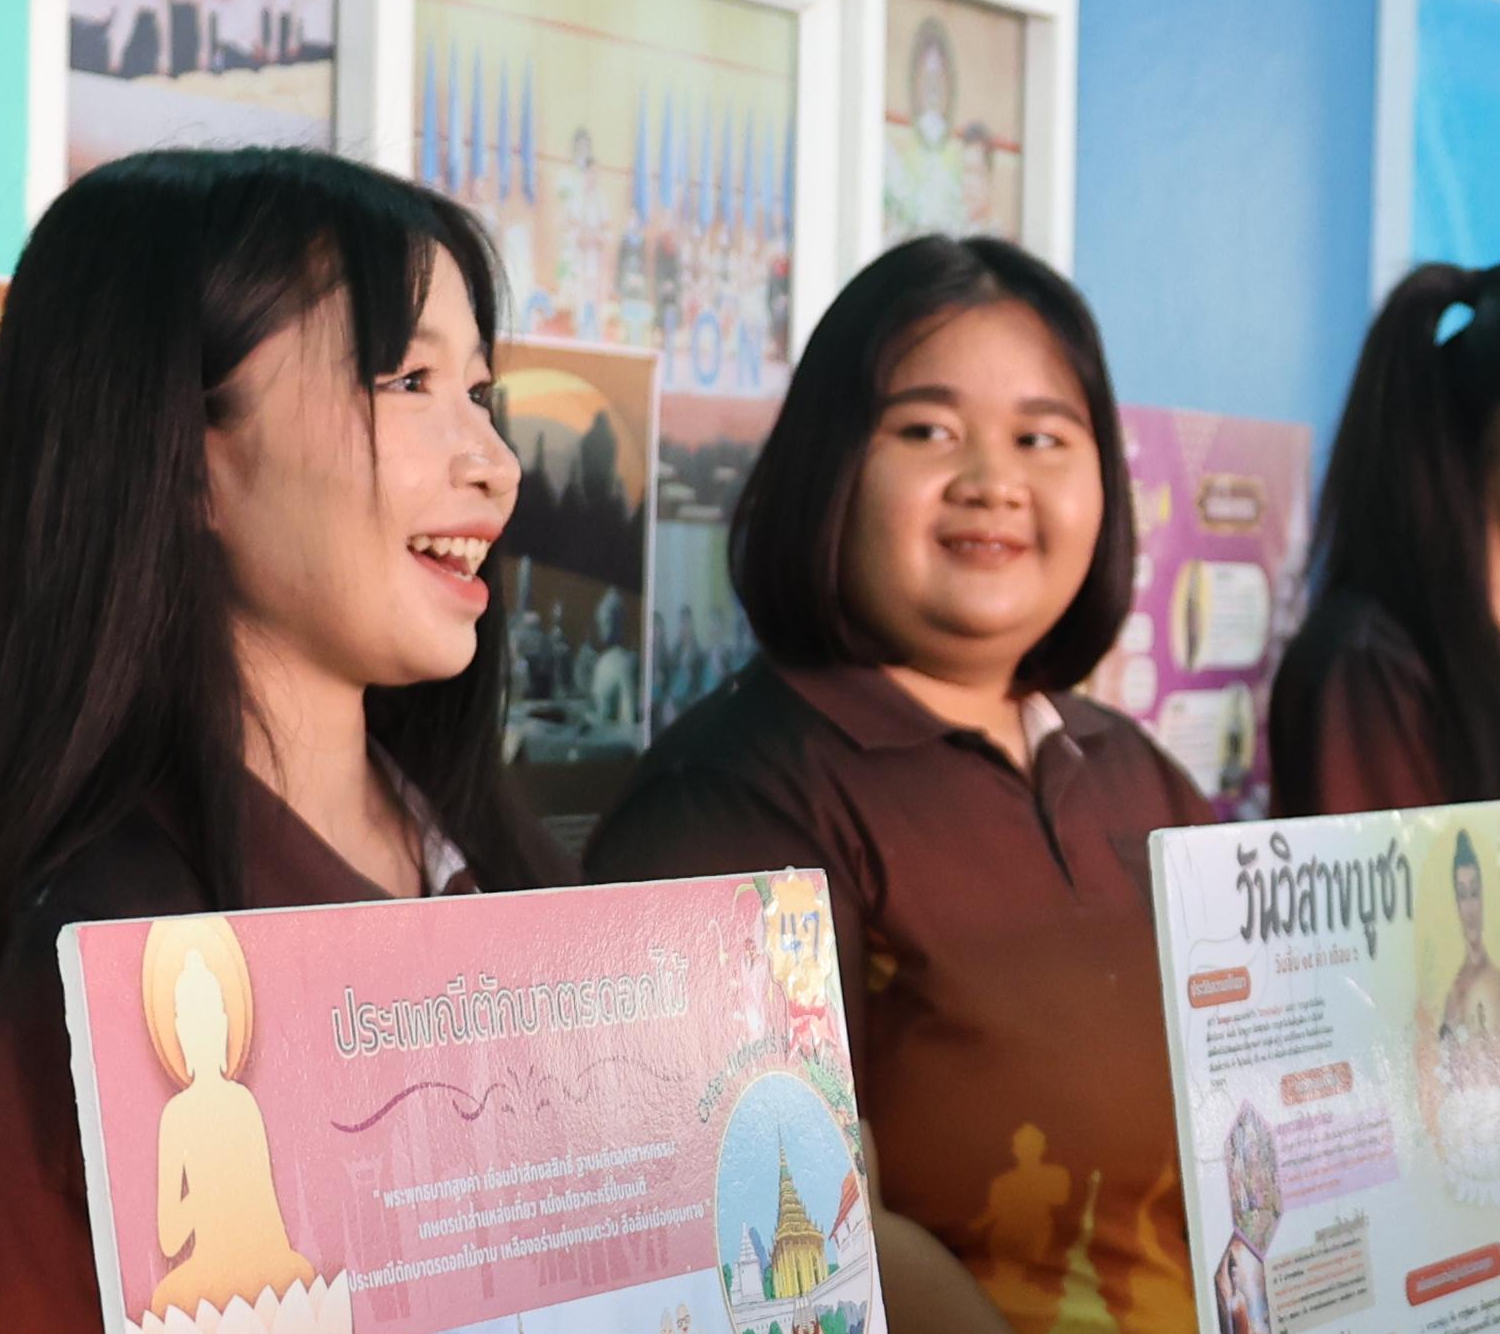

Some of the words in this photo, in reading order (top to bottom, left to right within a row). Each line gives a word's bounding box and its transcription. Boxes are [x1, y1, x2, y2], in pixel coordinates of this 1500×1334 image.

[1237, 832, 1414, 961] วันวิสาขบูชา
[331, 946, 690, 1060] ประเพณีตักบาตรดอกไม้
